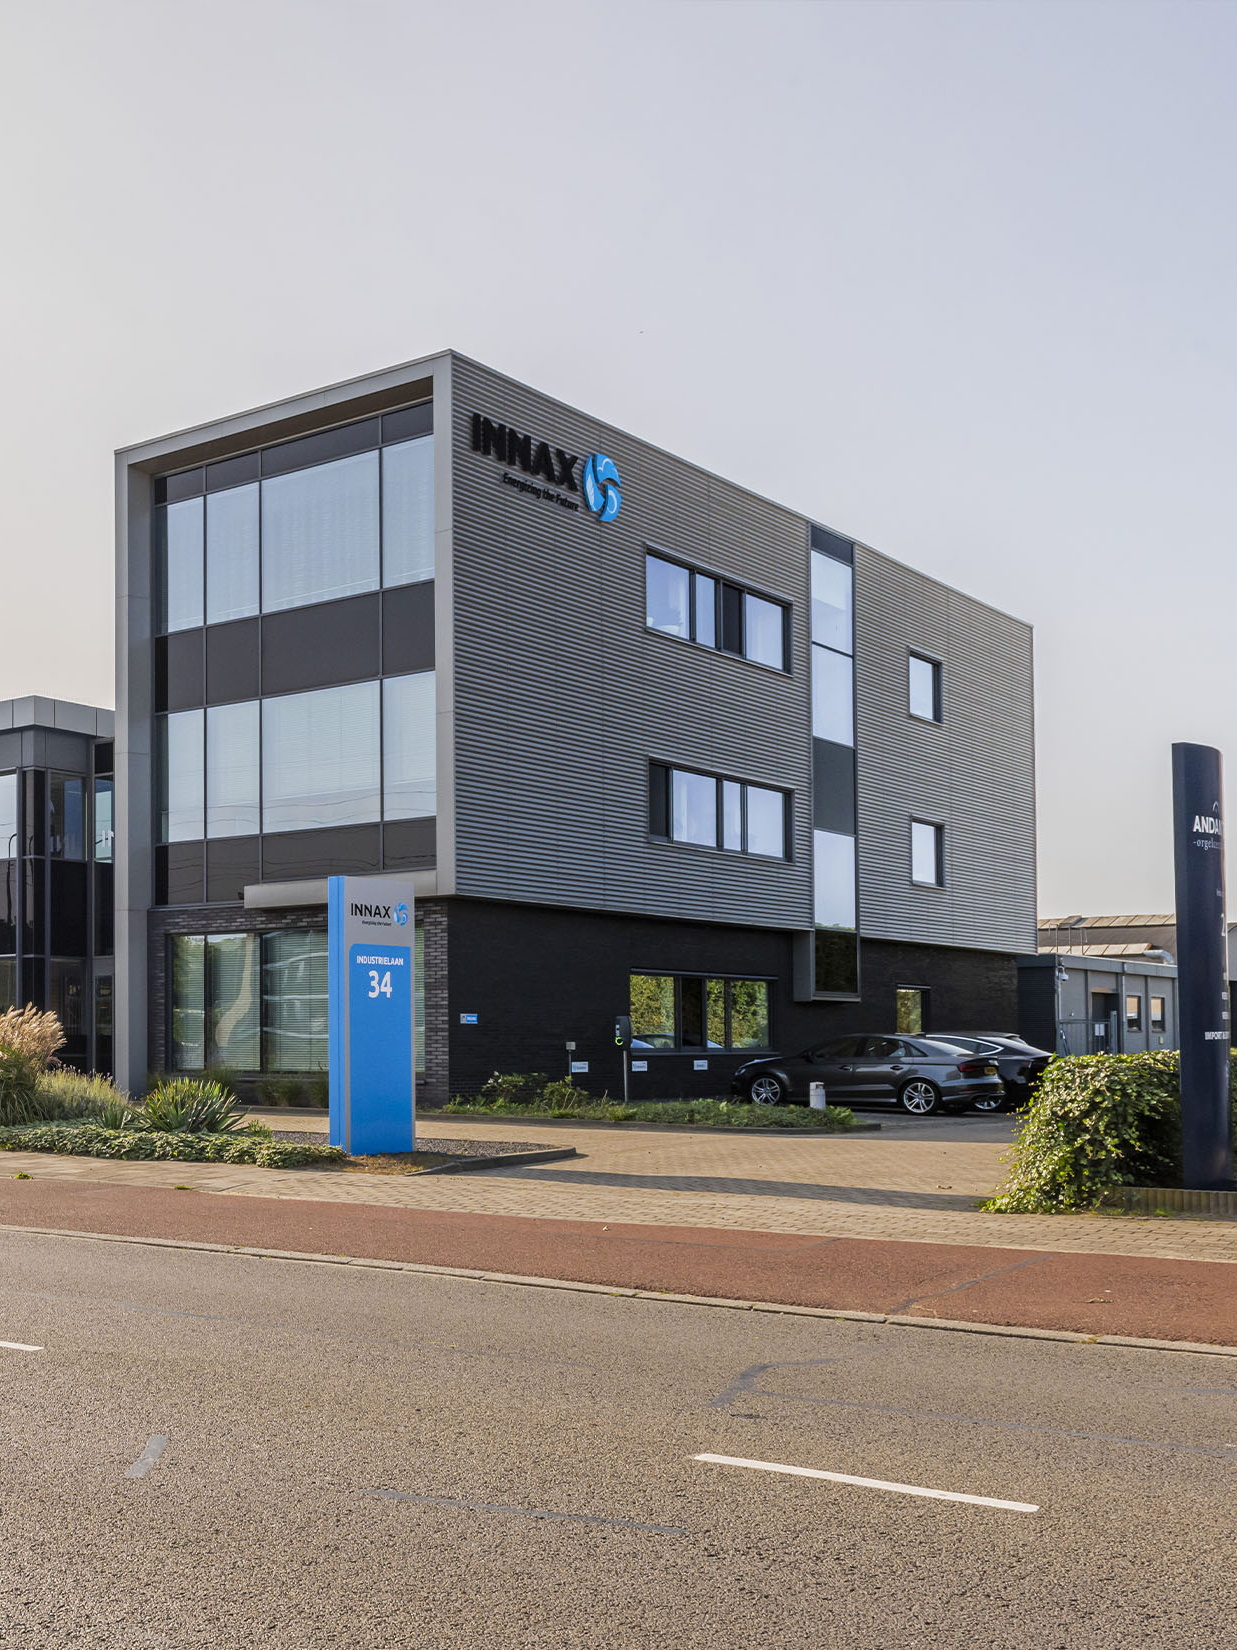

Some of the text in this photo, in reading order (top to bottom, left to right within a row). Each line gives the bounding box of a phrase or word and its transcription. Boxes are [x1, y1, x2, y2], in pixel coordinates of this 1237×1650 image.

[472, 412, 578, 492] INNAX
[503, 472, 579, 512] Energizing the Future
[351, 903, 391, 919] INNAX
[357, 955, 404, 966] INDUSTRIELAAN
[368, 970, 392, 998] 34
